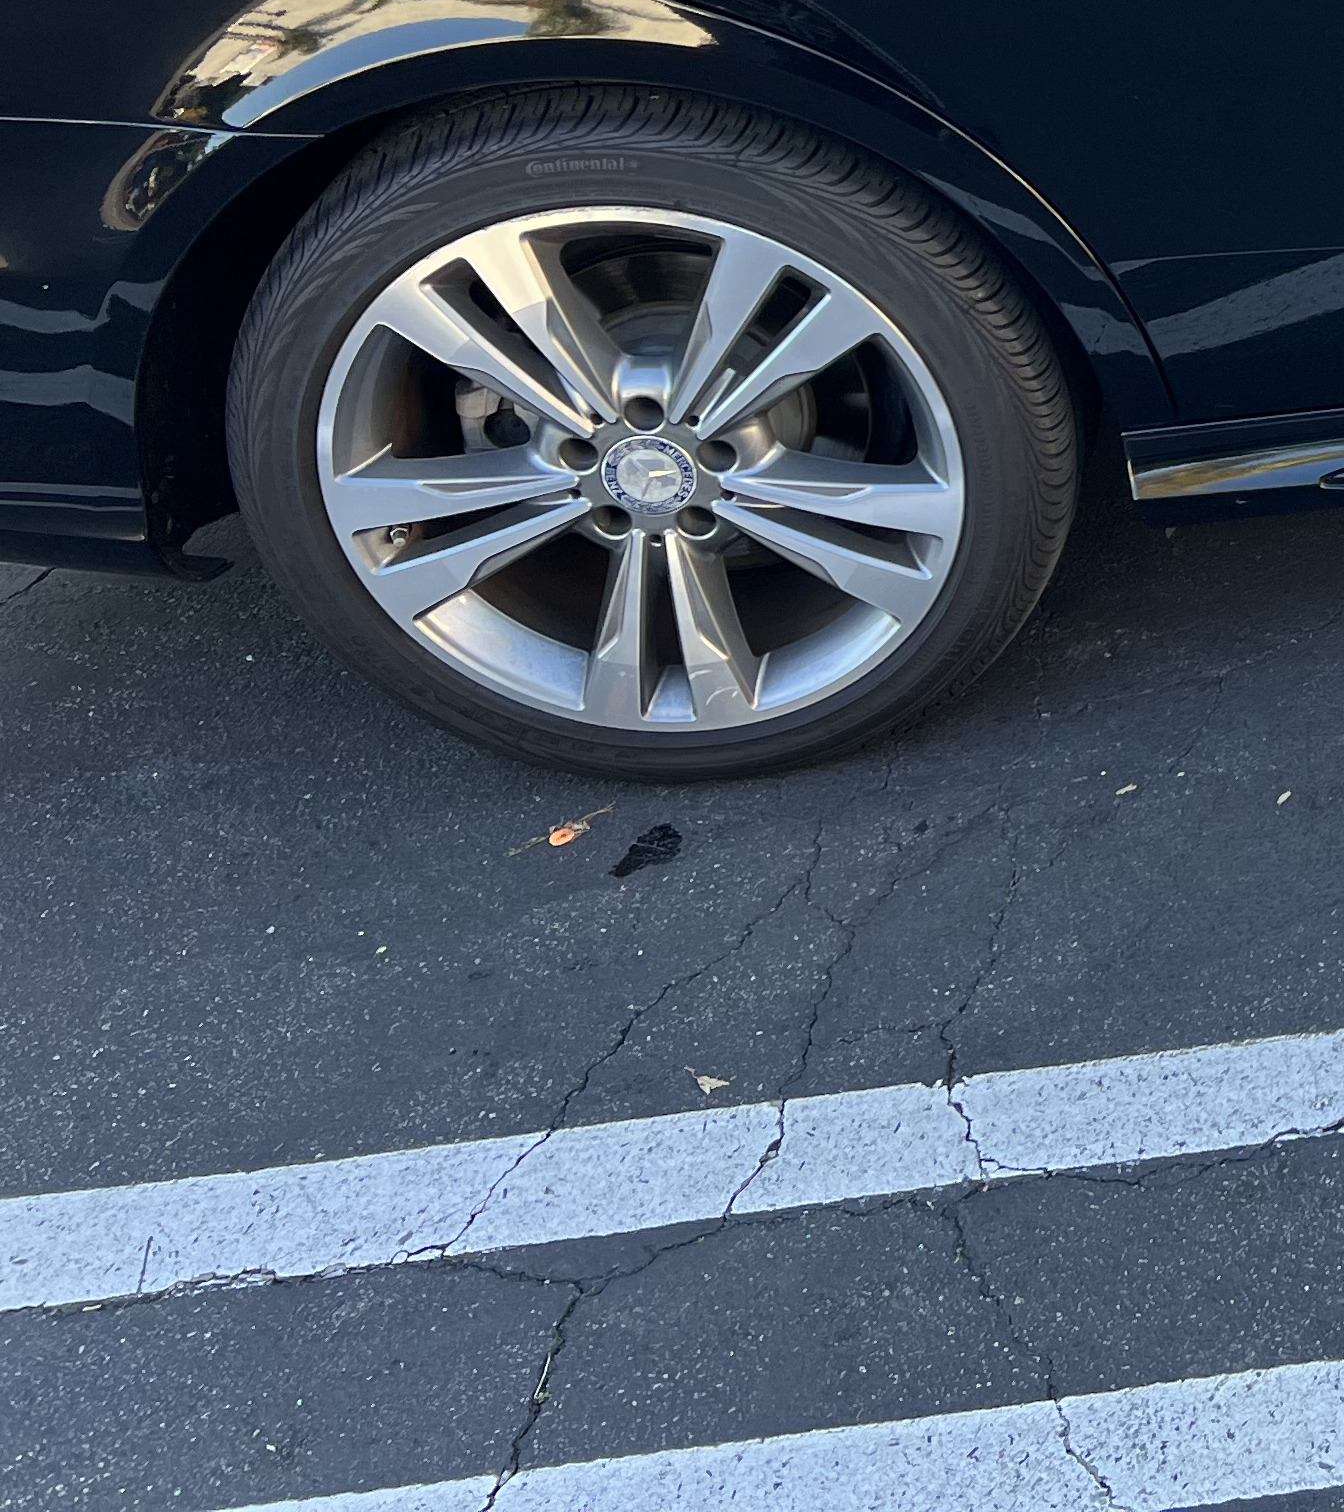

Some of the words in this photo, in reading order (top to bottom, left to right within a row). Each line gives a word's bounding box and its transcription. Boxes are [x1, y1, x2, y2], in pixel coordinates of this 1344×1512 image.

[524, 157, 626, 179] Continental
[604, 467, 626, 498] BENZ
[661, 443, 694, 499] MERCEDES
